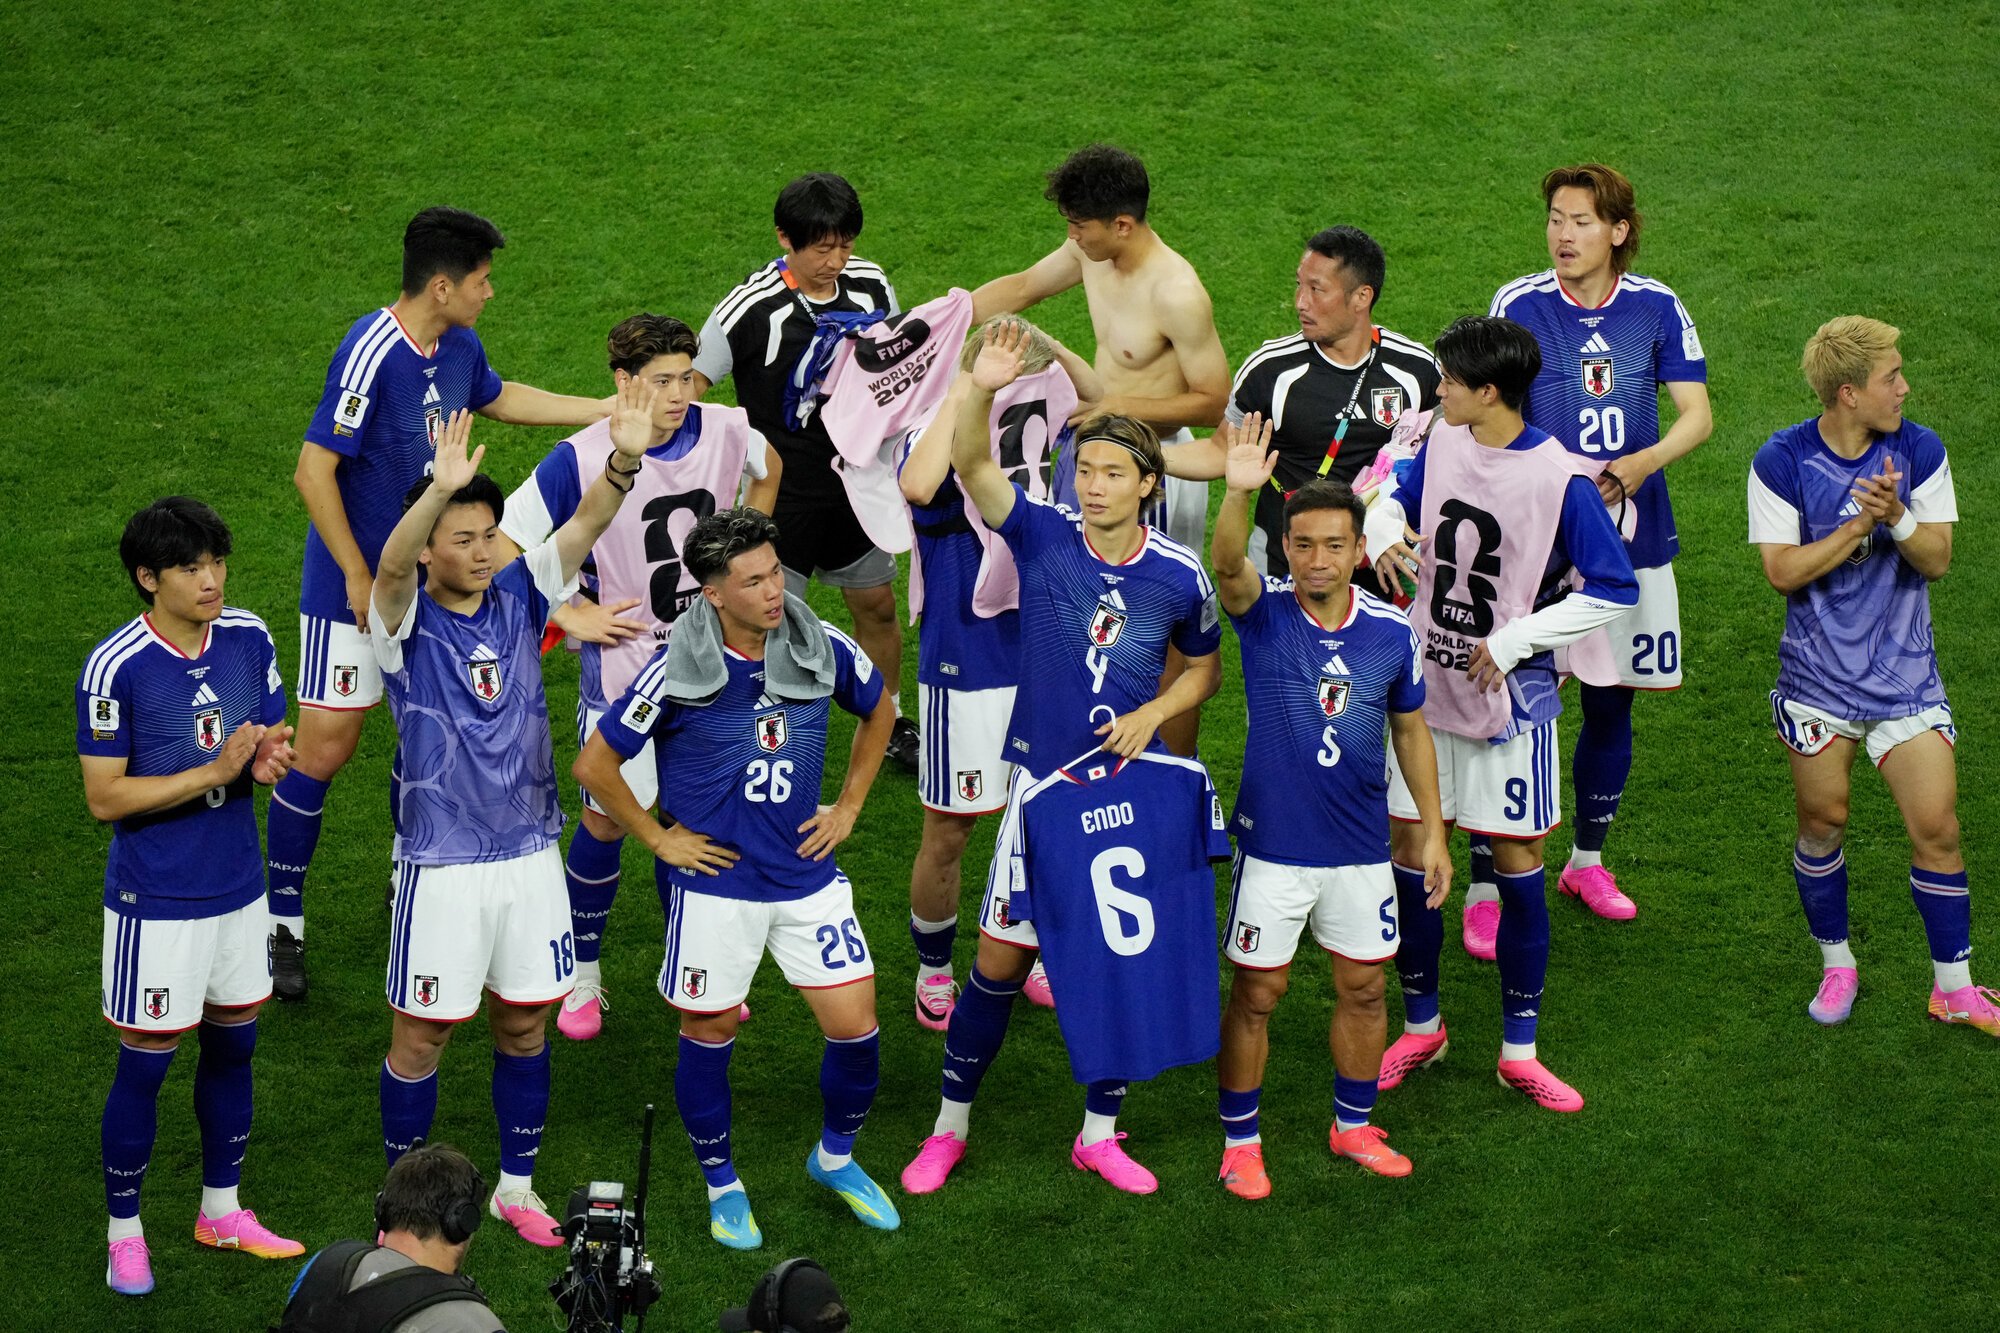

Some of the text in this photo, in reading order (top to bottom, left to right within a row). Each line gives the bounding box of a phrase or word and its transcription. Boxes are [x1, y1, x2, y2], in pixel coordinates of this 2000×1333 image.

[868, 342, 936, 393] WORLD CUP
[876, 338, 913, 361] FIFA
[1579, 406, 1625, 453] 20
[675, 593, 700, 611] FIF
[1442, 604, 1476, 626] FIFA
[1425, 643, 1470, 672] 202
[1427, 628, 1466, 650] WORLD
[1632, 630, 1678, 675] 20
[1085, 645, 1109, 694] 4
[744, 759, 794, 804] 26
[1503, 777, 1528, 821] 9
[1080, 801, 1135, 834] ENDO
[268, 860, 308, 872] JAPAN
[1090, 846, 1155, 957] 6
[1379, 895, 1397, 942] 5
[549, 931, 574, 982] 18
[816, 917, 866, 970] 26
[512, 1125, 544, 1136] JAP
[106, 1163, 148, 1177] JAPAN
